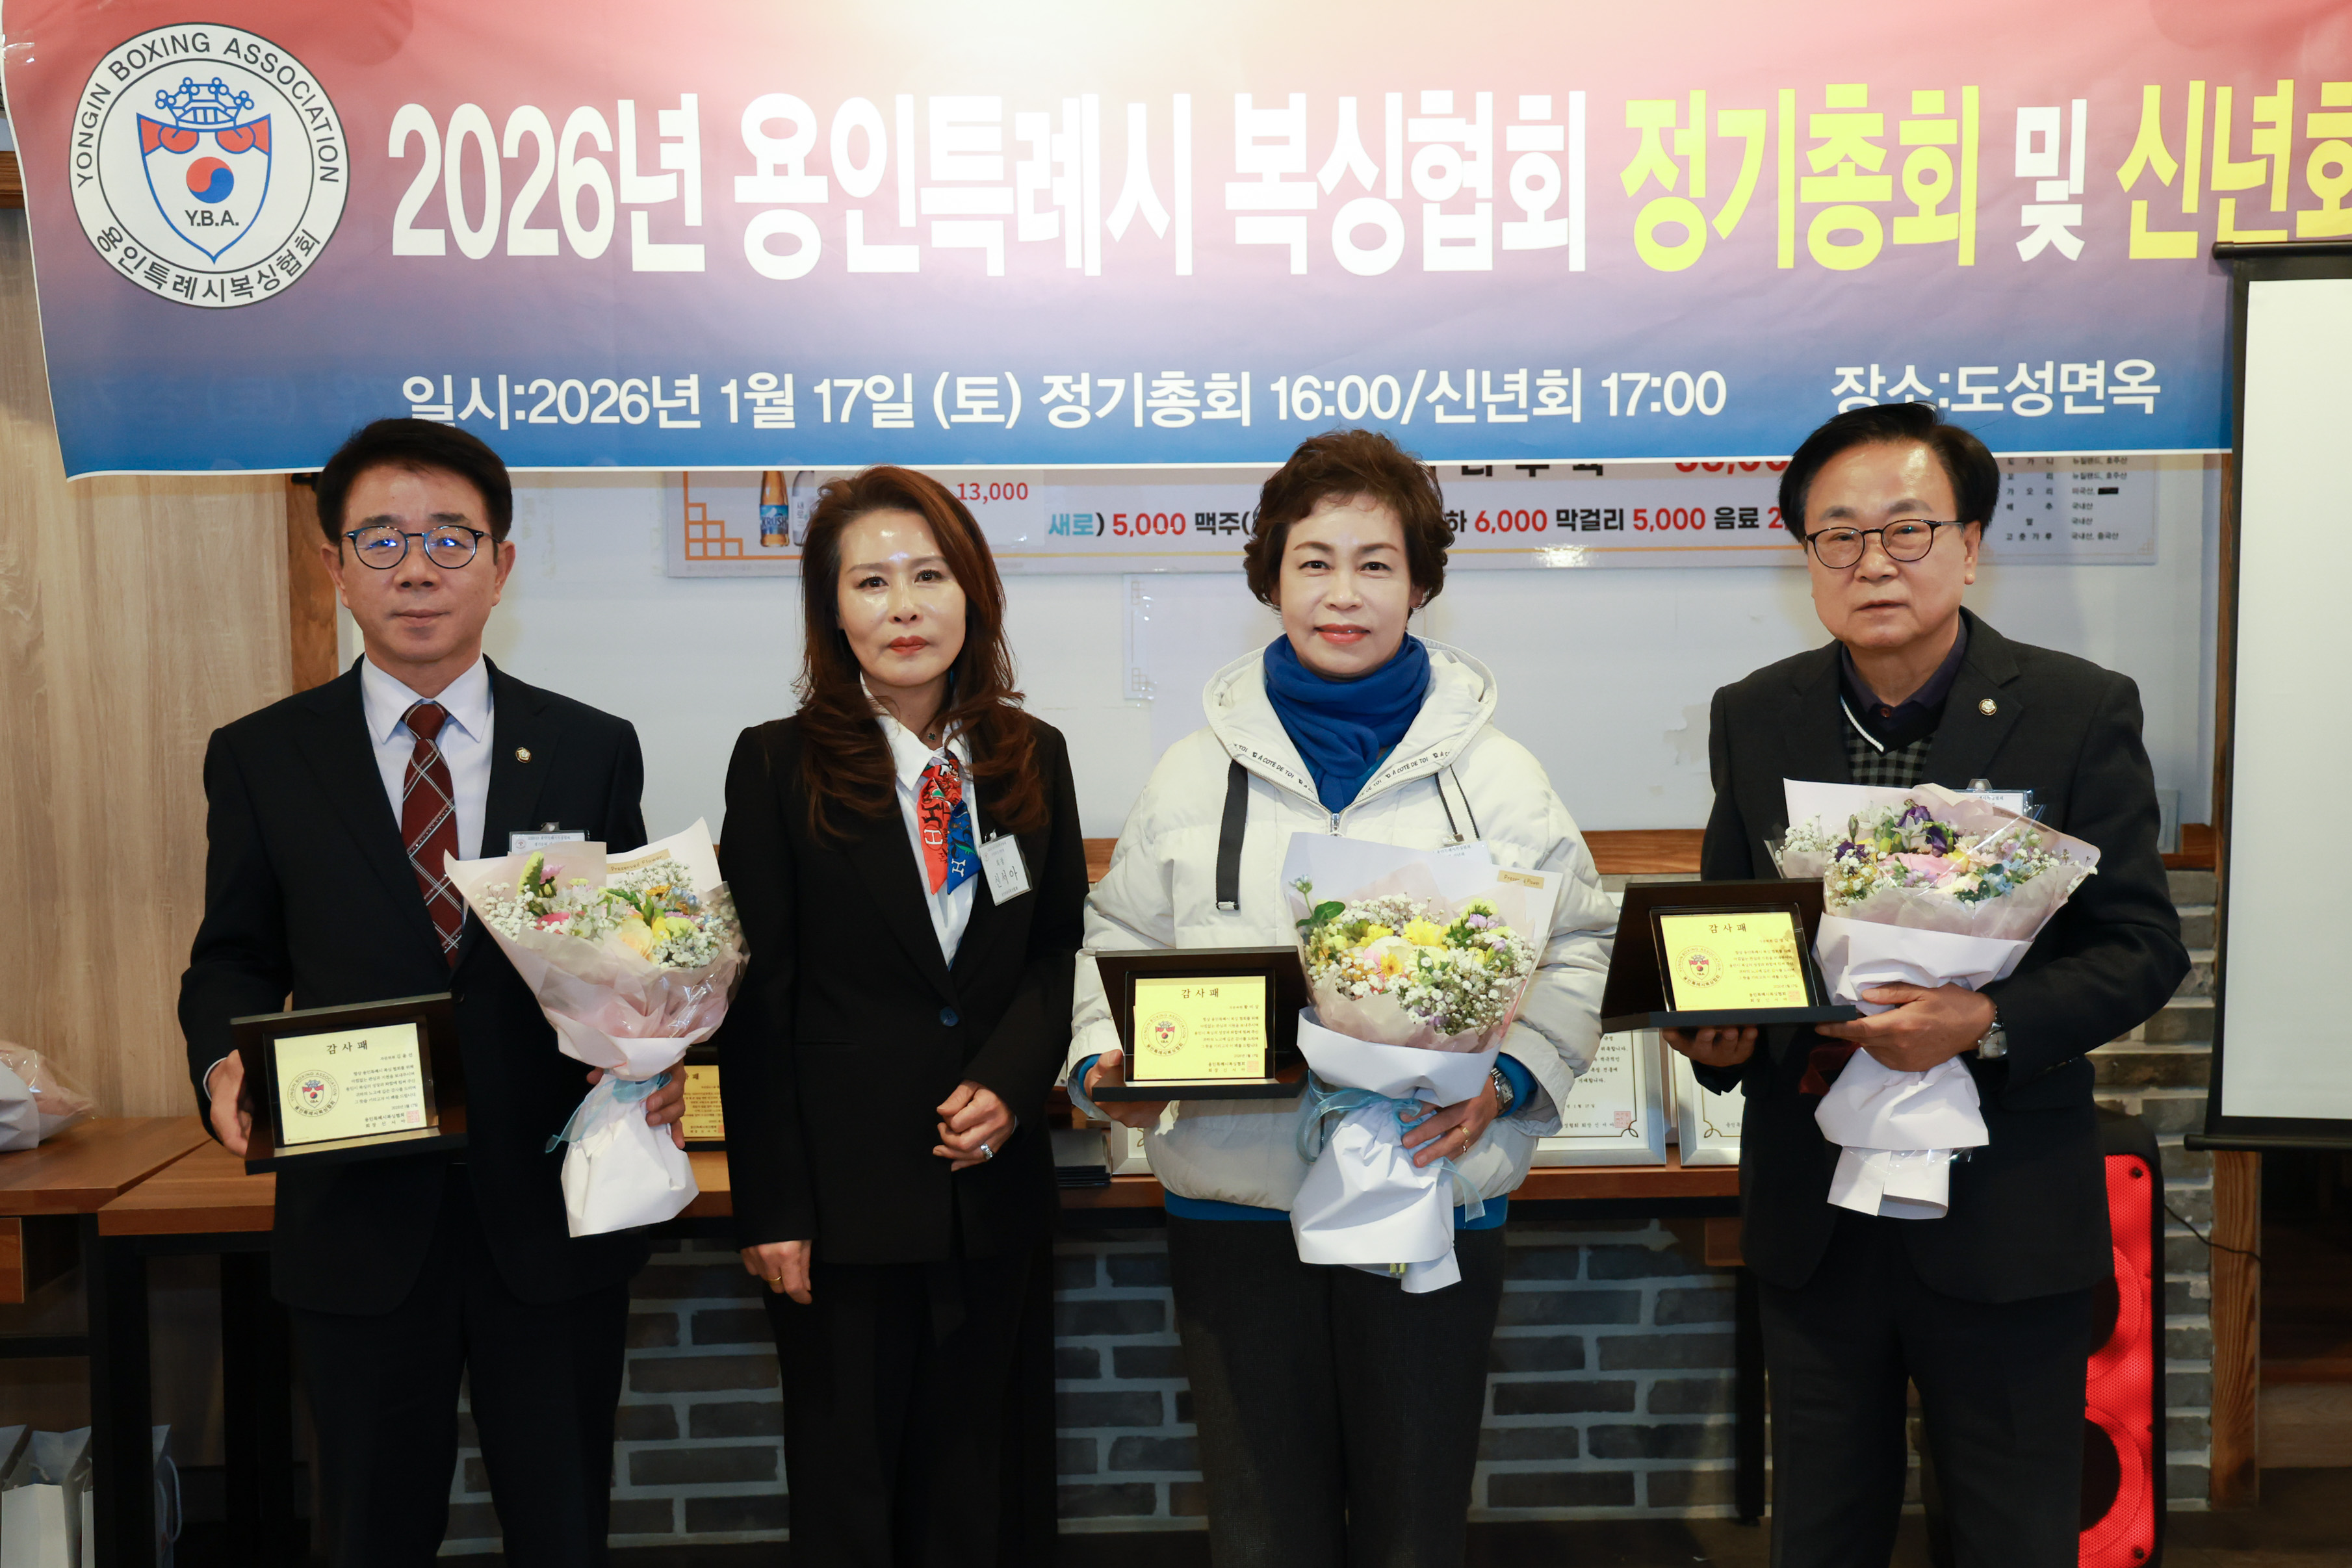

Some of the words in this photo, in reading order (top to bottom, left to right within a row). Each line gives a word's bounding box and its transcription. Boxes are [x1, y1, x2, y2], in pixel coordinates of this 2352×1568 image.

[76, 84, 112, 188] YONGIN
[108, 32, 211, 79] BOXING
[223, 40, 339, 183] ASSOCIATION
[389, 93, 705, 272] 2026년
[734, 92, 1193, 280] 용인특례시
[1225, 90, 1586, 276] 복싱협회
[1619, 83, 1980, 272] 정기총회
[2015, 98, 2087, 262] 및
[184, 209, 240, 227] Y.B.A.
[96, 227, 321, 302] 용인특례시복싱협회
[402, 373, 701, 431] 일시:2026년
[721, 372, 795, 430] 1월
[813, 372, 914, 430] 17일
[933, 371, 1022, 430] (토)
[1039, 370, 1251, 430] 정기총회
[1270, 367, 1582, 426] 16:00/신년회
[1601, 369, 1727, 417] 17:00
[957, 482, 1028, 504] 13,000
[1048, 513, 1104, 537] 새로)
[1113, 513, 1186, 537] 5,000
[1474, 510, 1548, 533] 6,000
[1556, 509, 1625, 531] 막걸리
[1633, 507, 1707, 532] 5,000
[1714, 507, 1759, 530] 음료
[1286, 770, 1294, 778] TOI
[611, 862, 640, 871] Preserved
[642, 855, 662, 864] Flower
